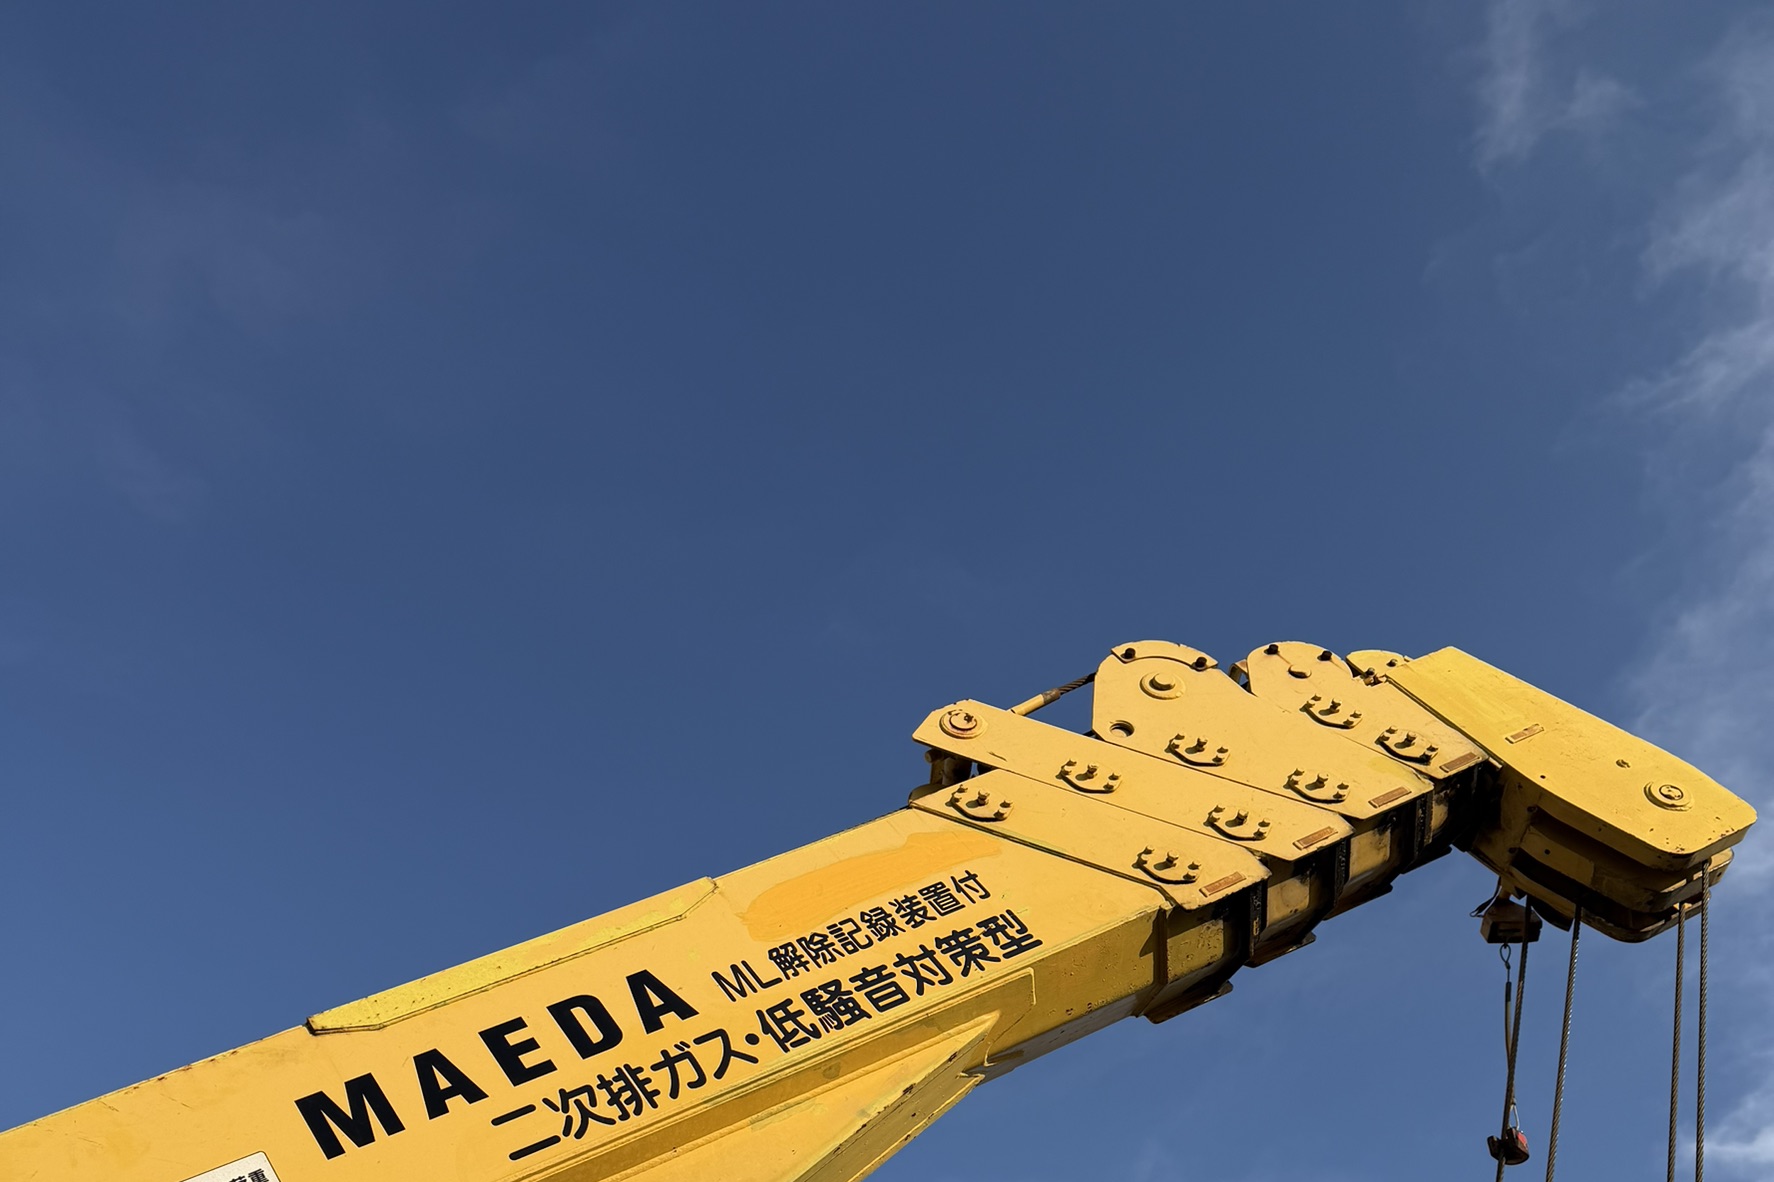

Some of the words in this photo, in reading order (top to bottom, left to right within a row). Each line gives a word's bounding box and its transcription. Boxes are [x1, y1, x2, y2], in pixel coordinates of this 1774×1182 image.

[711, 869, 991, 1002] ML解除記録装置付
[297, 969, 699, 1160] MAEDA
[491, 909, 1043, 1161] 二次排ガス・低騒音対策型
